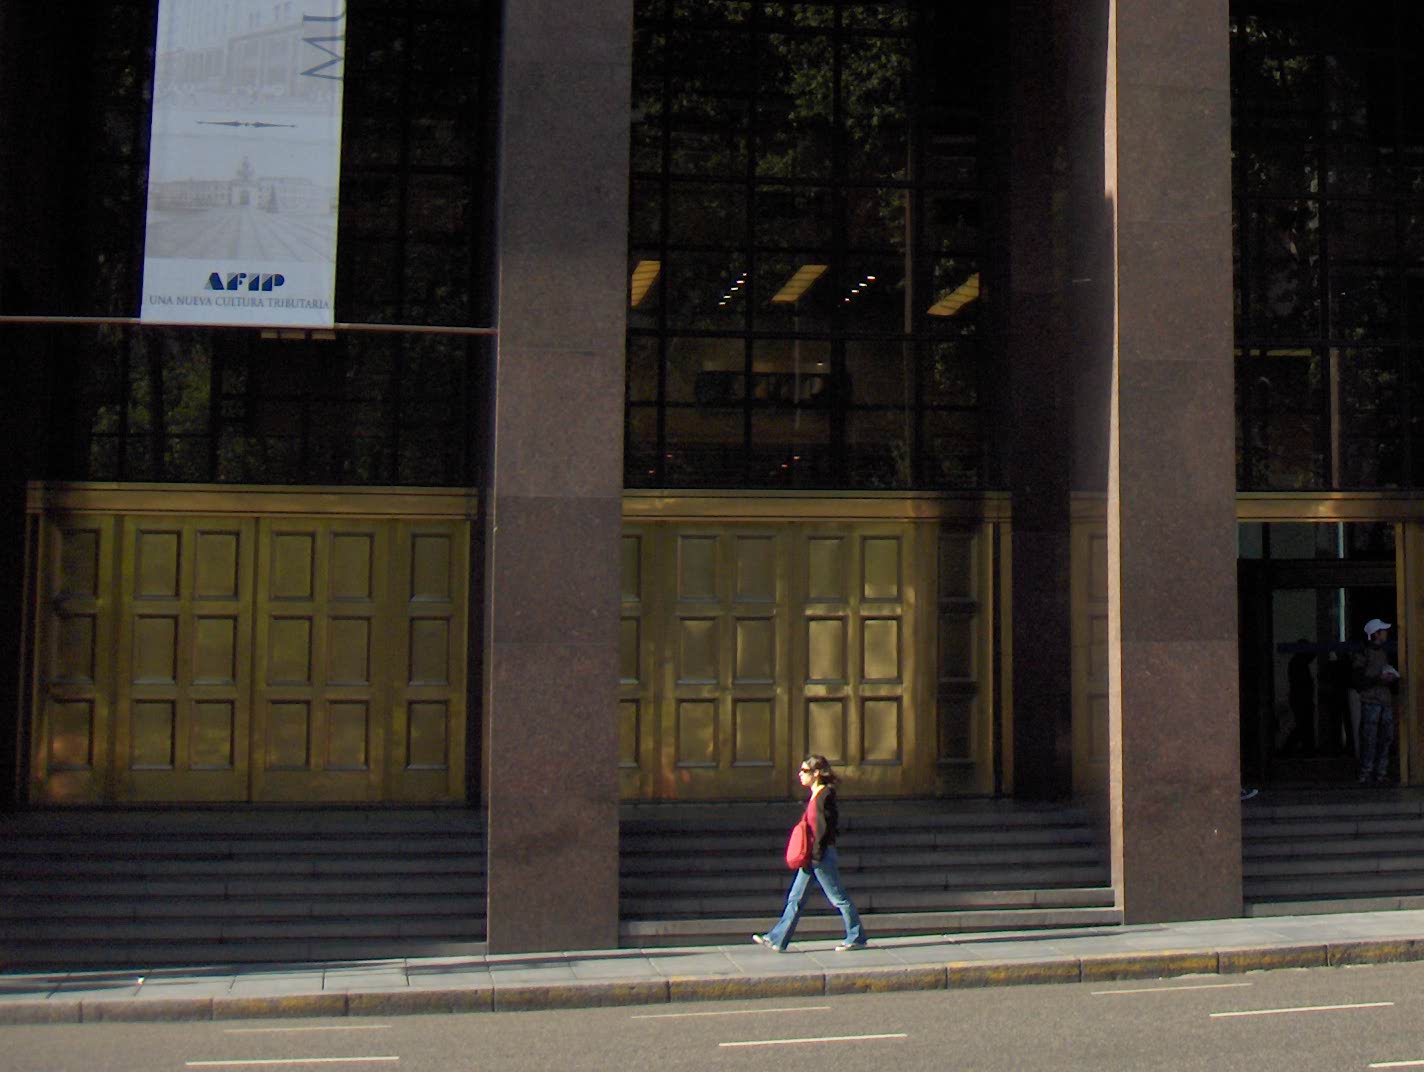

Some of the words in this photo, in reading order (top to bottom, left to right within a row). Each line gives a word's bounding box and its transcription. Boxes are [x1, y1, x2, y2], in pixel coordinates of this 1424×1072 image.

[204, 272, 285, 291] AFIP
[149, 295, 172, 305] UNA
[176, 296, 213, 307] NUEVA
[215, 297, 264, 308] CULTURA
[268, 298, 330, 310] TRIBUTARIA
